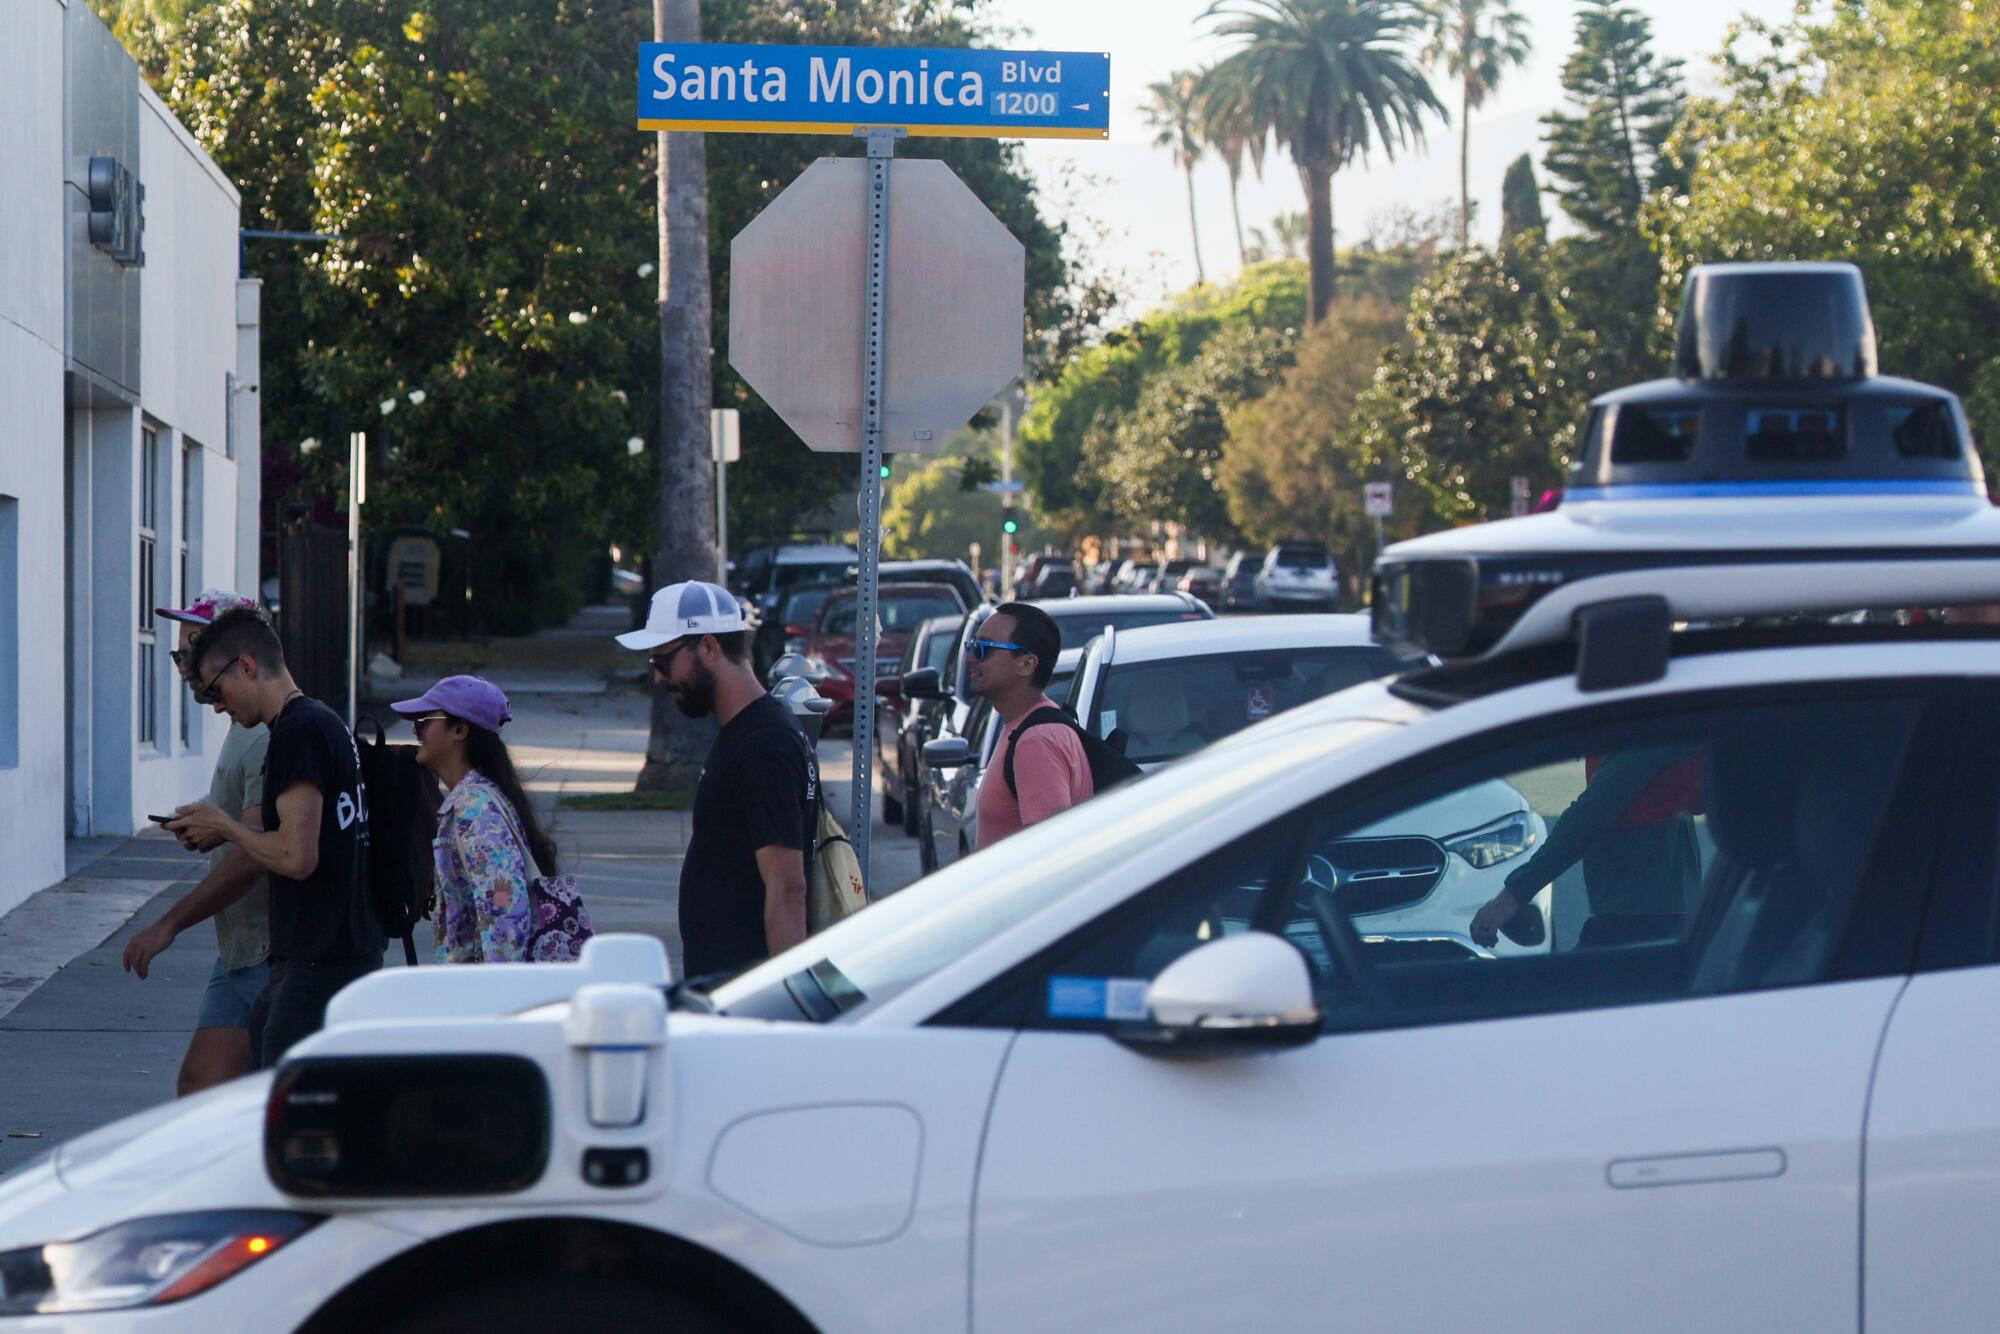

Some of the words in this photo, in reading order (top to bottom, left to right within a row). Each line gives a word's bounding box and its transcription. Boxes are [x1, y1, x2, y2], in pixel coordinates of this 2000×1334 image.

[652, 53, 787, 102] Santa
[809, 56, 984, 106] Monica
[1002, 60, 1062, 83] Blvd
[995, 92, 1056, 115] 1200
